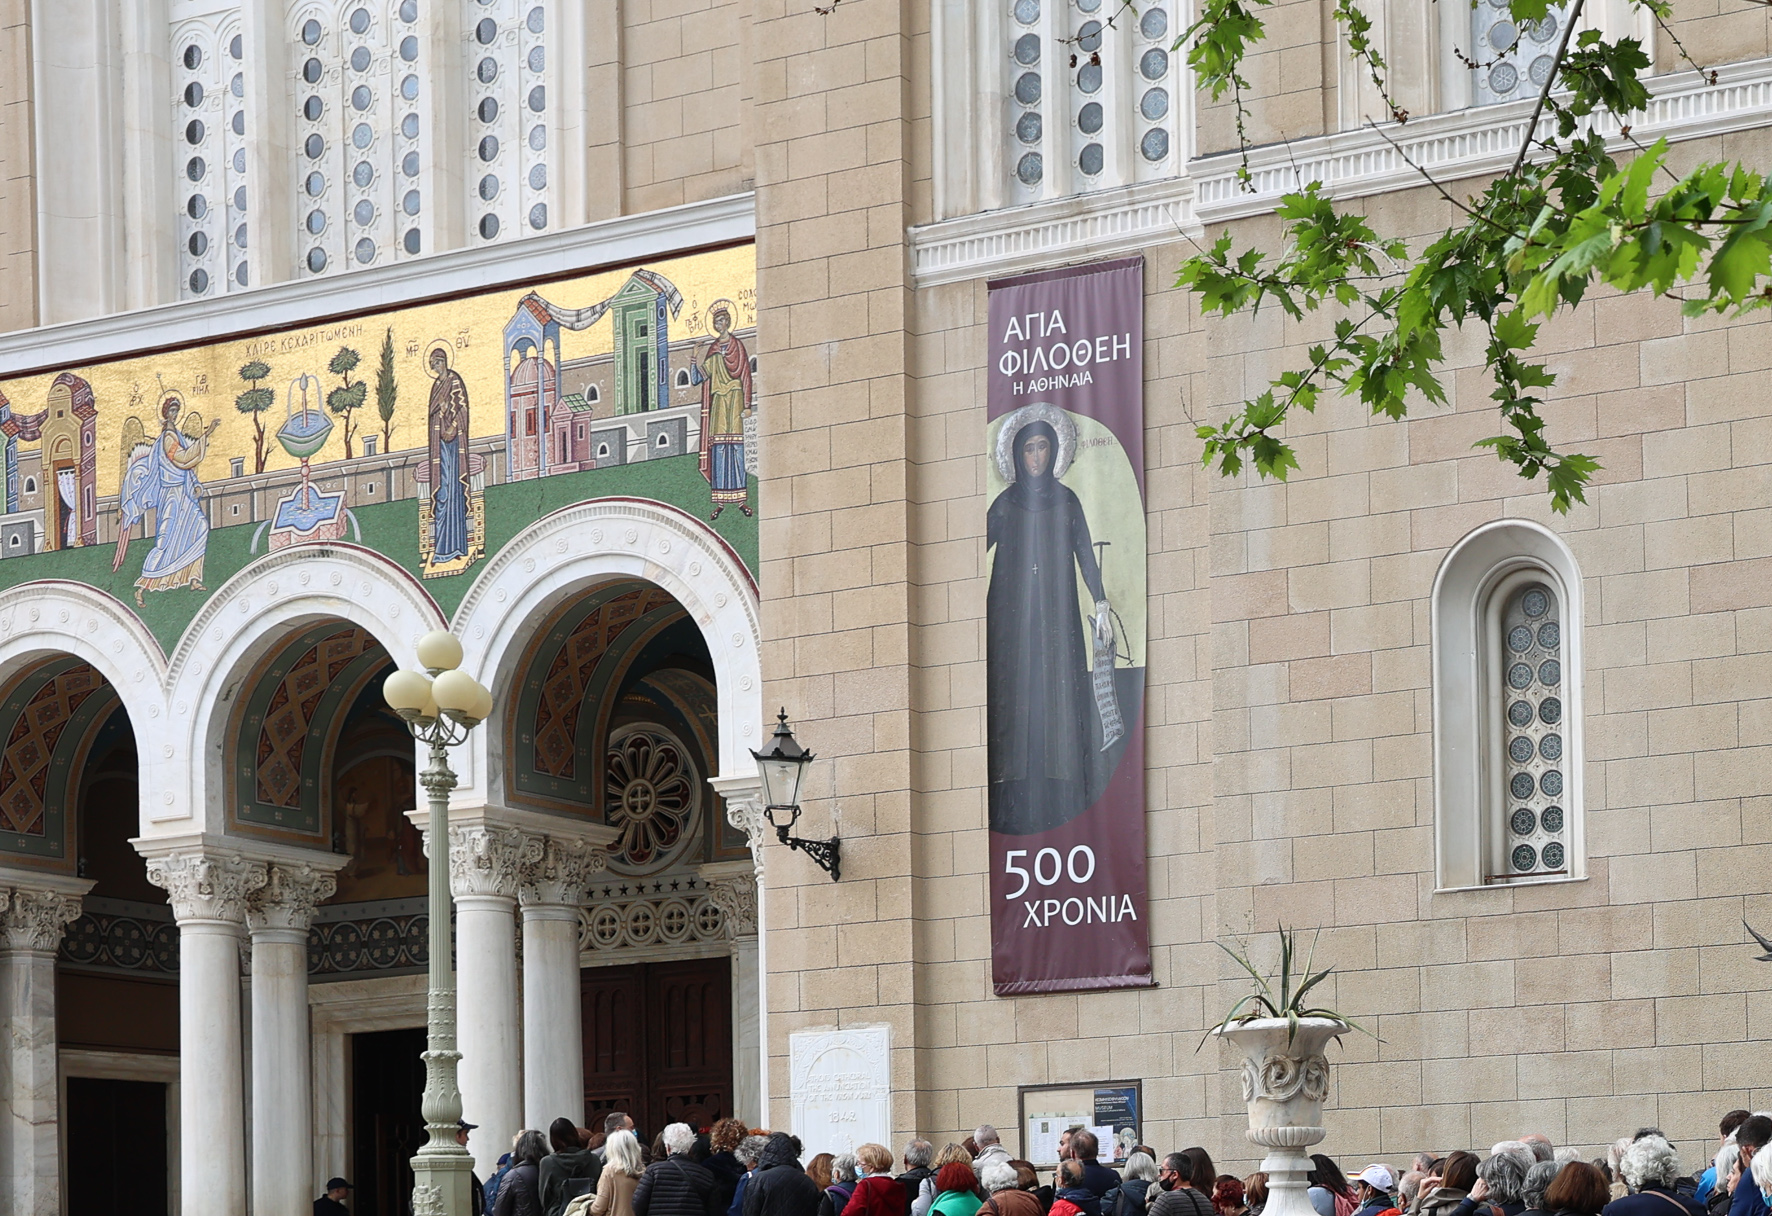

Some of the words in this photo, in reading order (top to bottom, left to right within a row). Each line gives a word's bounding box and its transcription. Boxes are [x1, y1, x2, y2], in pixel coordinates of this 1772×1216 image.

[1003, 309, 1067, 344] ΑΓΙΑ
[999, 333, 1131, 377] ΦΙΛΟΘΕΗ
[1013, 381, 1023, 395] Η
[1027, 370, 1093, 394] ΑΘΗΝΑΙΑ
[1005, 844, 1096, 900] 500
[1022, 893, 1138, 928] ΧΡΟΝΙΑ
